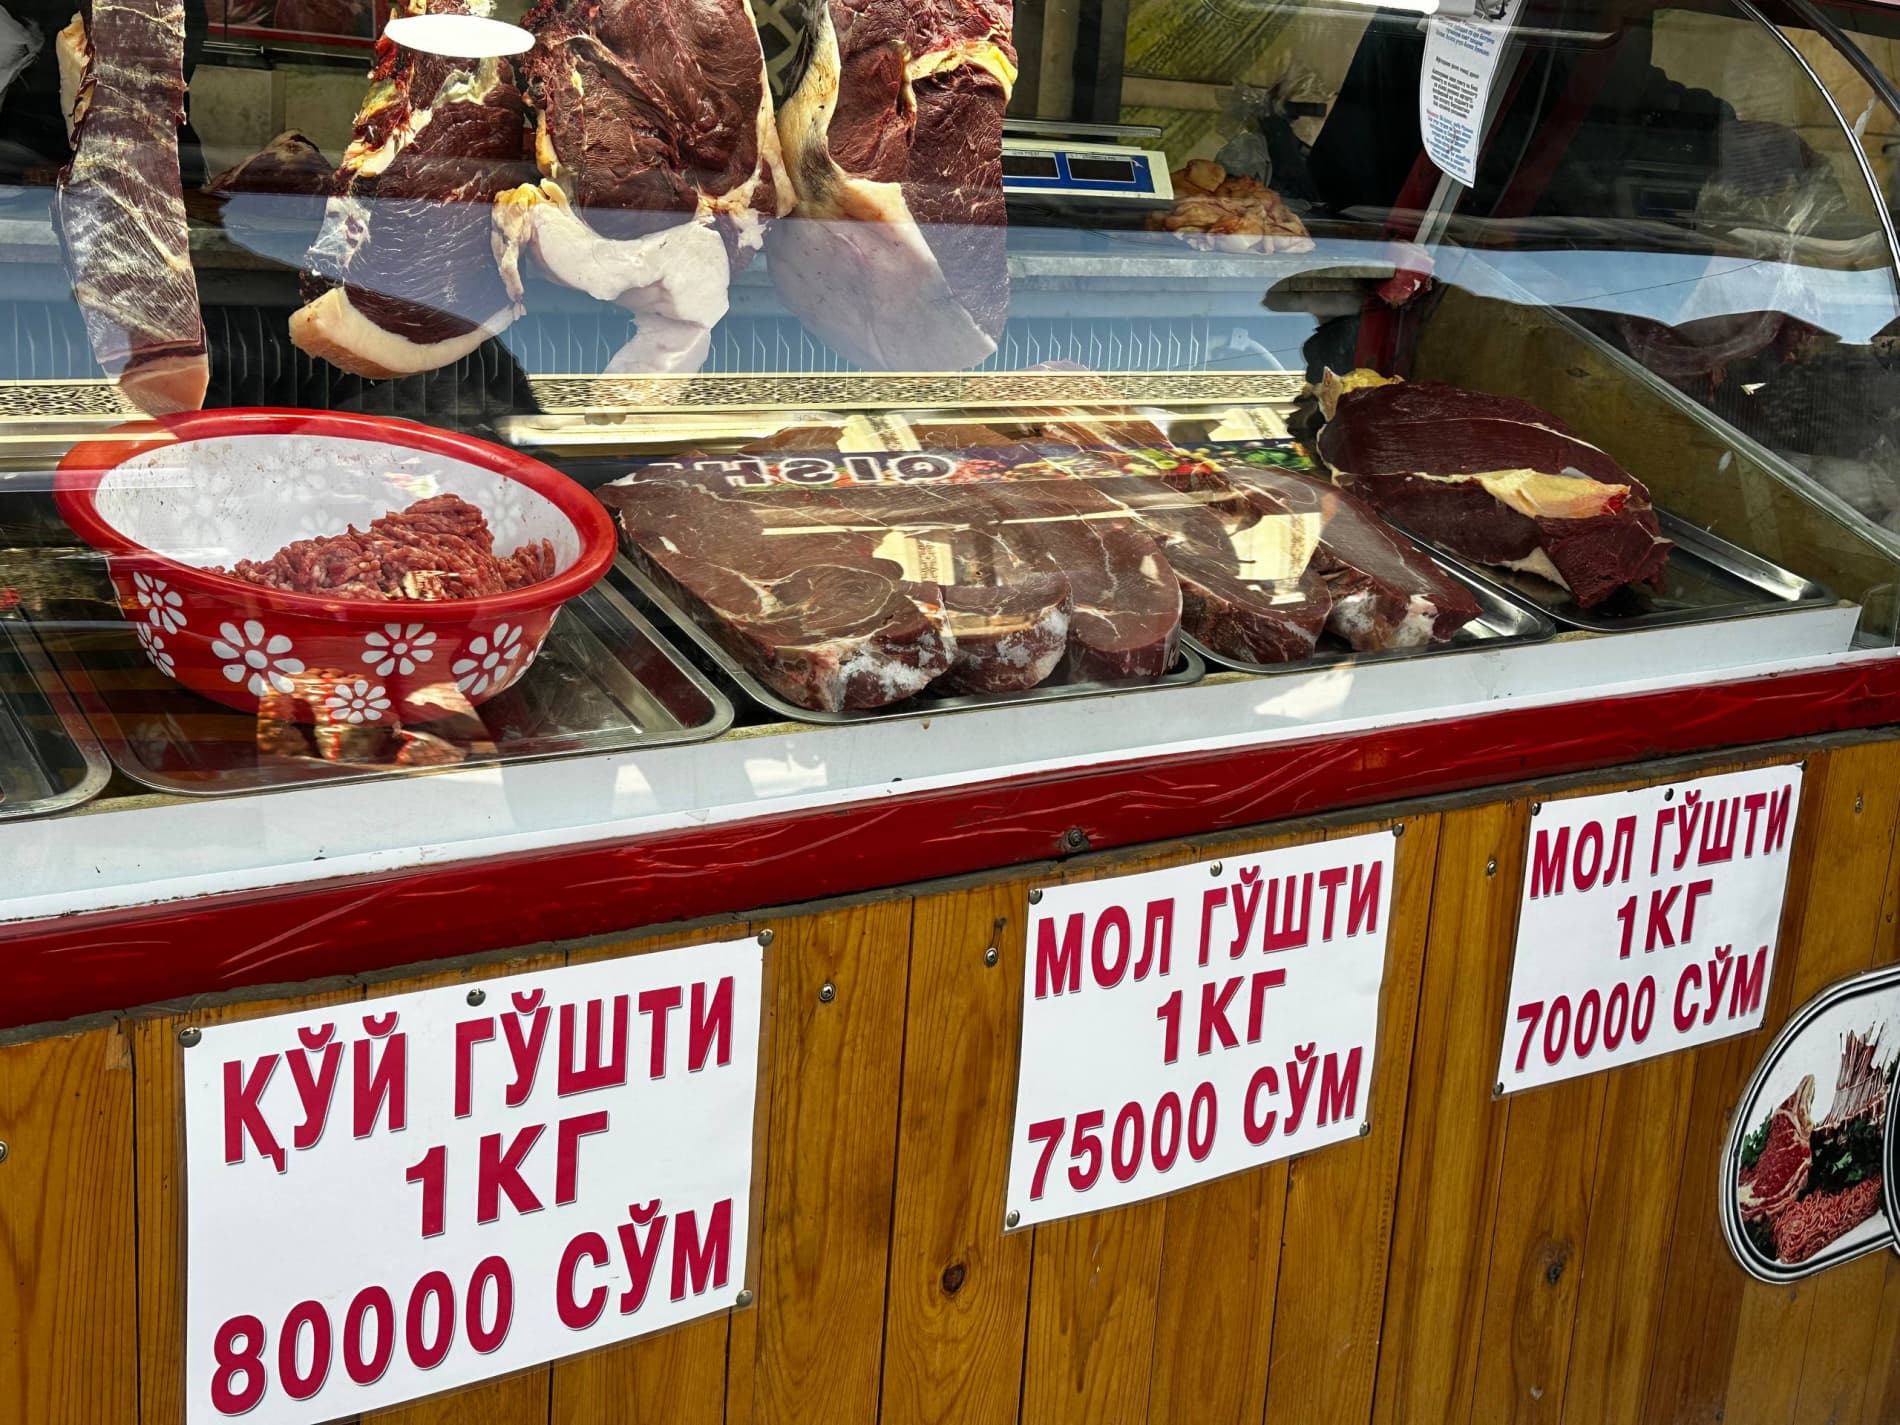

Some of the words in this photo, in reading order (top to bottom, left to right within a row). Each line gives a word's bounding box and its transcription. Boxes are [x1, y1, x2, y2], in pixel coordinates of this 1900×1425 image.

[1530, 815, 1638, 899] МОЛ
[1650, 785, 1792, 875] ГЎШТИ
[1034, 897, 1176, 999] МОЛ
[1198, 860, 1383, 966] ГЎШТИ
[223, 1011, 407, 1173] ҚЎЙ
[454, 976, 735, 1118] ГЎШТИ
[1515, 975, 1657, 1073] 70000
[1673, 946, 1768, 1033] СЎМ
[1028, 1081, 1219, 1201] 75000
[1243, 1042, 1363, 1146] СЎМ
[210, 1255, 514, 1416] 80000
[556, 1199, 733, 1330] СЎМ
